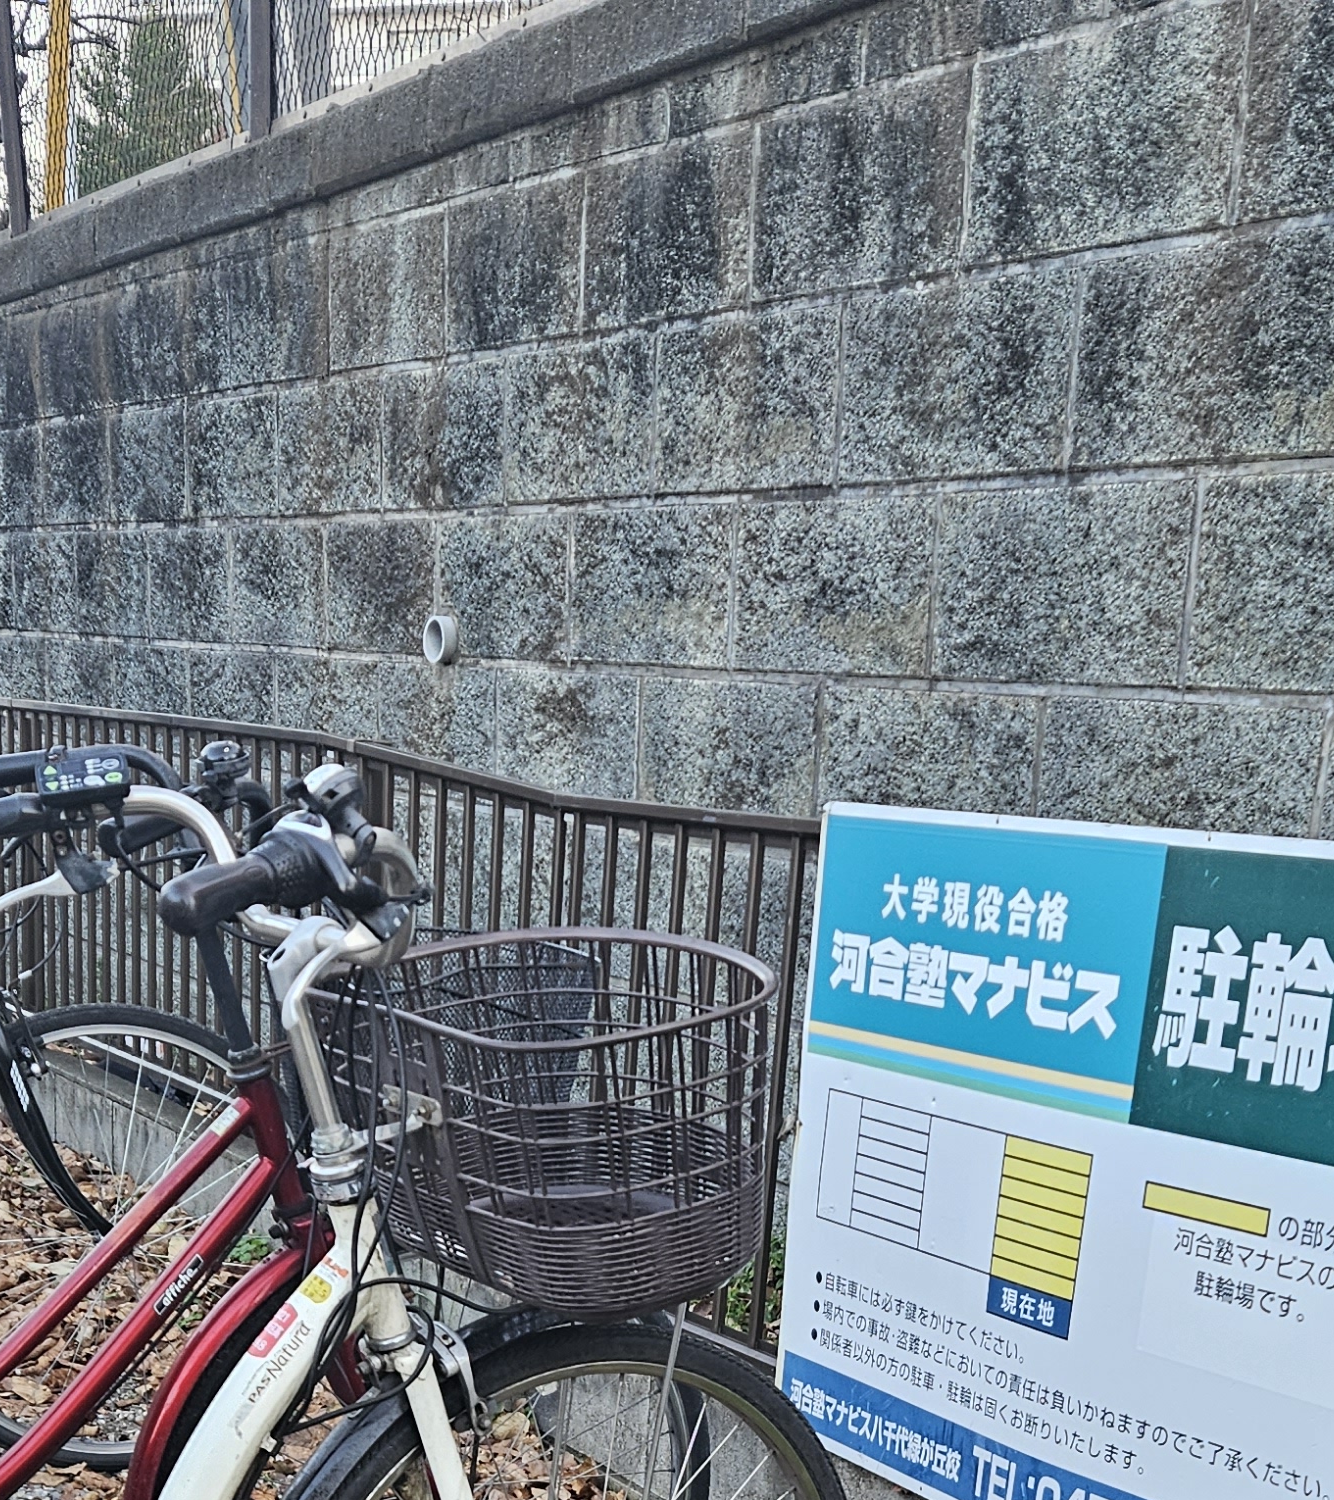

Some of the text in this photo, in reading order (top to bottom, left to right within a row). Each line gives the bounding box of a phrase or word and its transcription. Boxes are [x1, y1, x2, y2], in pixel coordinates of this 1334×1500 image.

[880, 872, 1070, 943] 大学現役合格
[828, 929, 1122, 1040] 河合塾マナビス
[162, 1265, 200, 1307] affiche
[1000, 1286, 1056, 1328] 現在地
[1193, 1270, 1307, 1324] 駐輪場です。
[824, 1272, 1025, 1365] 自転車には必ず鍵をかけてください。
[248, 1376, 271, 1404] PAS
[789, 1376, 962, 1483] 河合塾マナビス八千代緑が丘校
